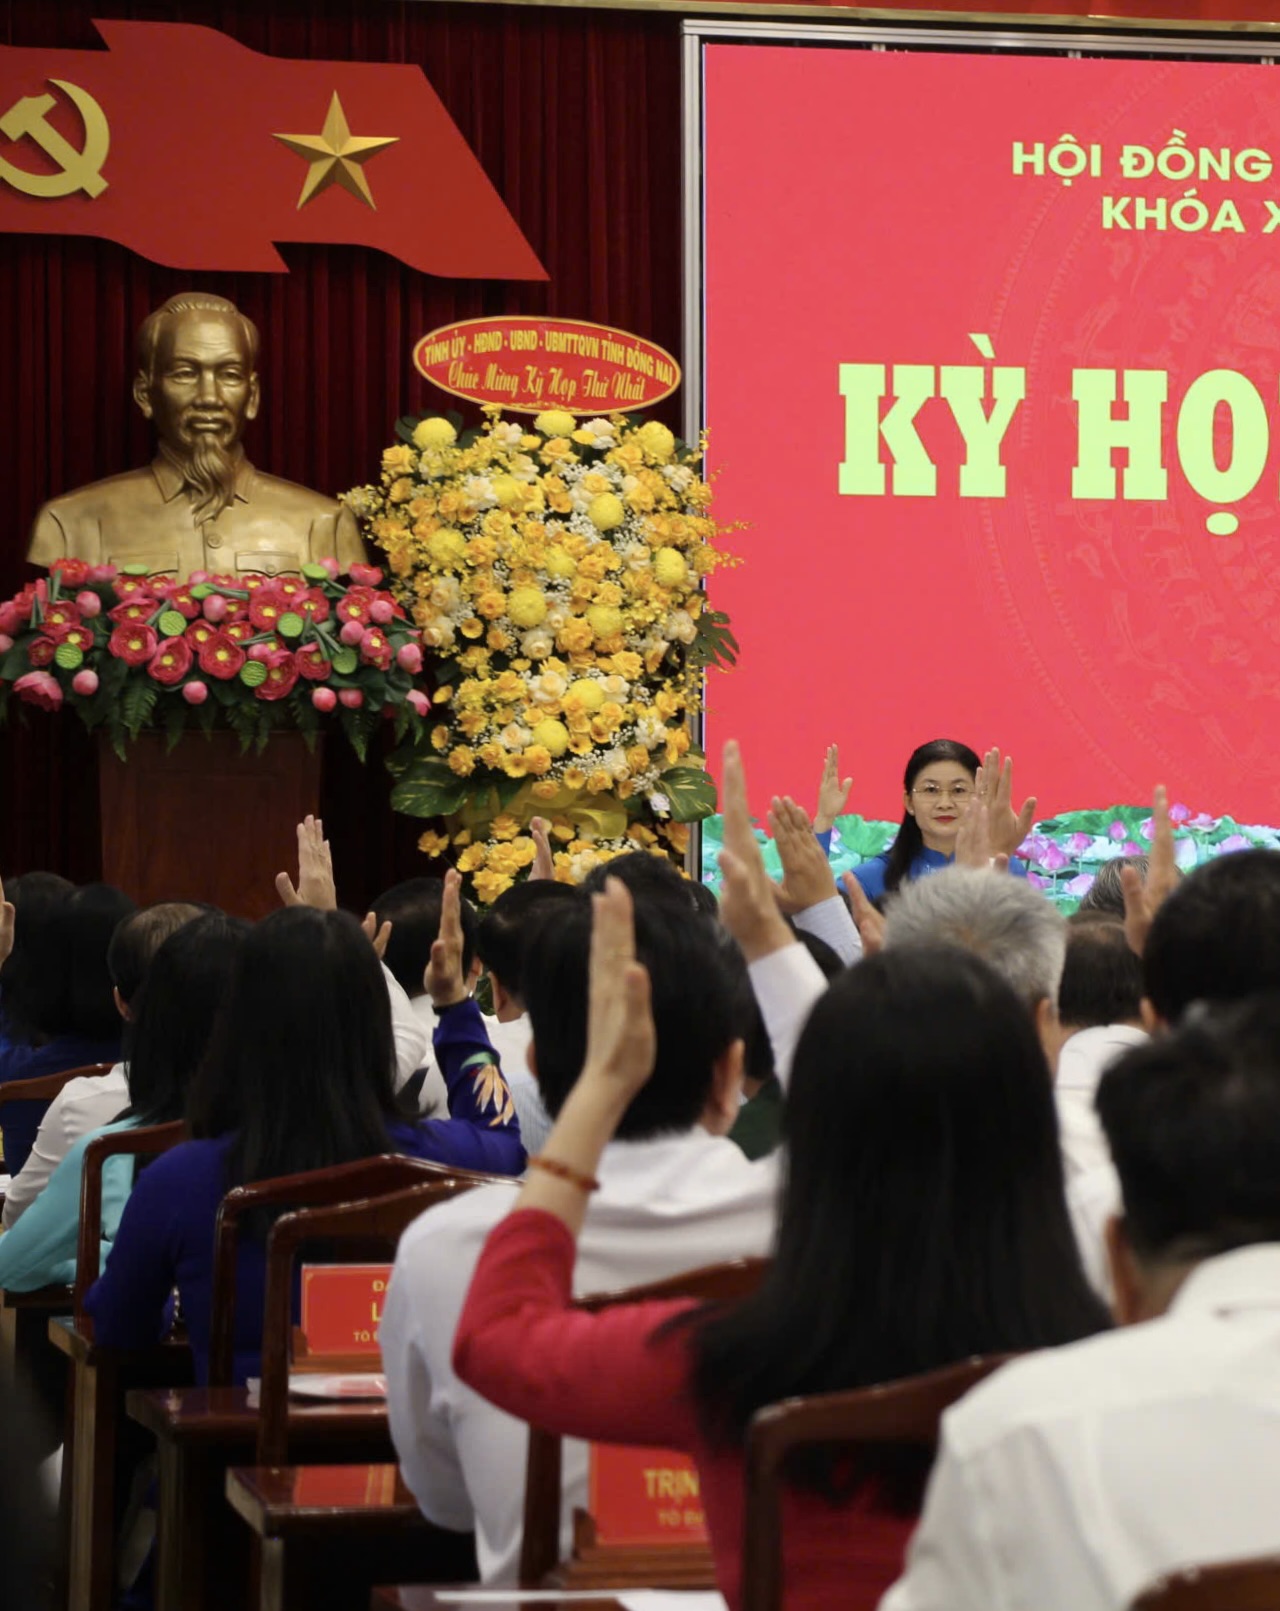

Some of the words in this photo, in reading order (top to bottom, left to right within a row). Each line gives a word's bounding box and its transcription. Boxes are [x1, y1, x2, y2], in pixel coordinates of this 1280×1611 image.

[1012, 133, 1102, 187] HỘI
[1119, 128, 1273, 183] ĐỒNG
[1102, 187, 1246, 233] KHÓA
[510, 330, 538, 351] UBND
[545, 330, 600, 359] UBMTTQVN
[601, 333, 625, 366] TỈNH
[655, 359, 673, 387] NAI
[838, 332, 1027, 498] KỲ
[643, 1469, 700, 1506] TRỊN
